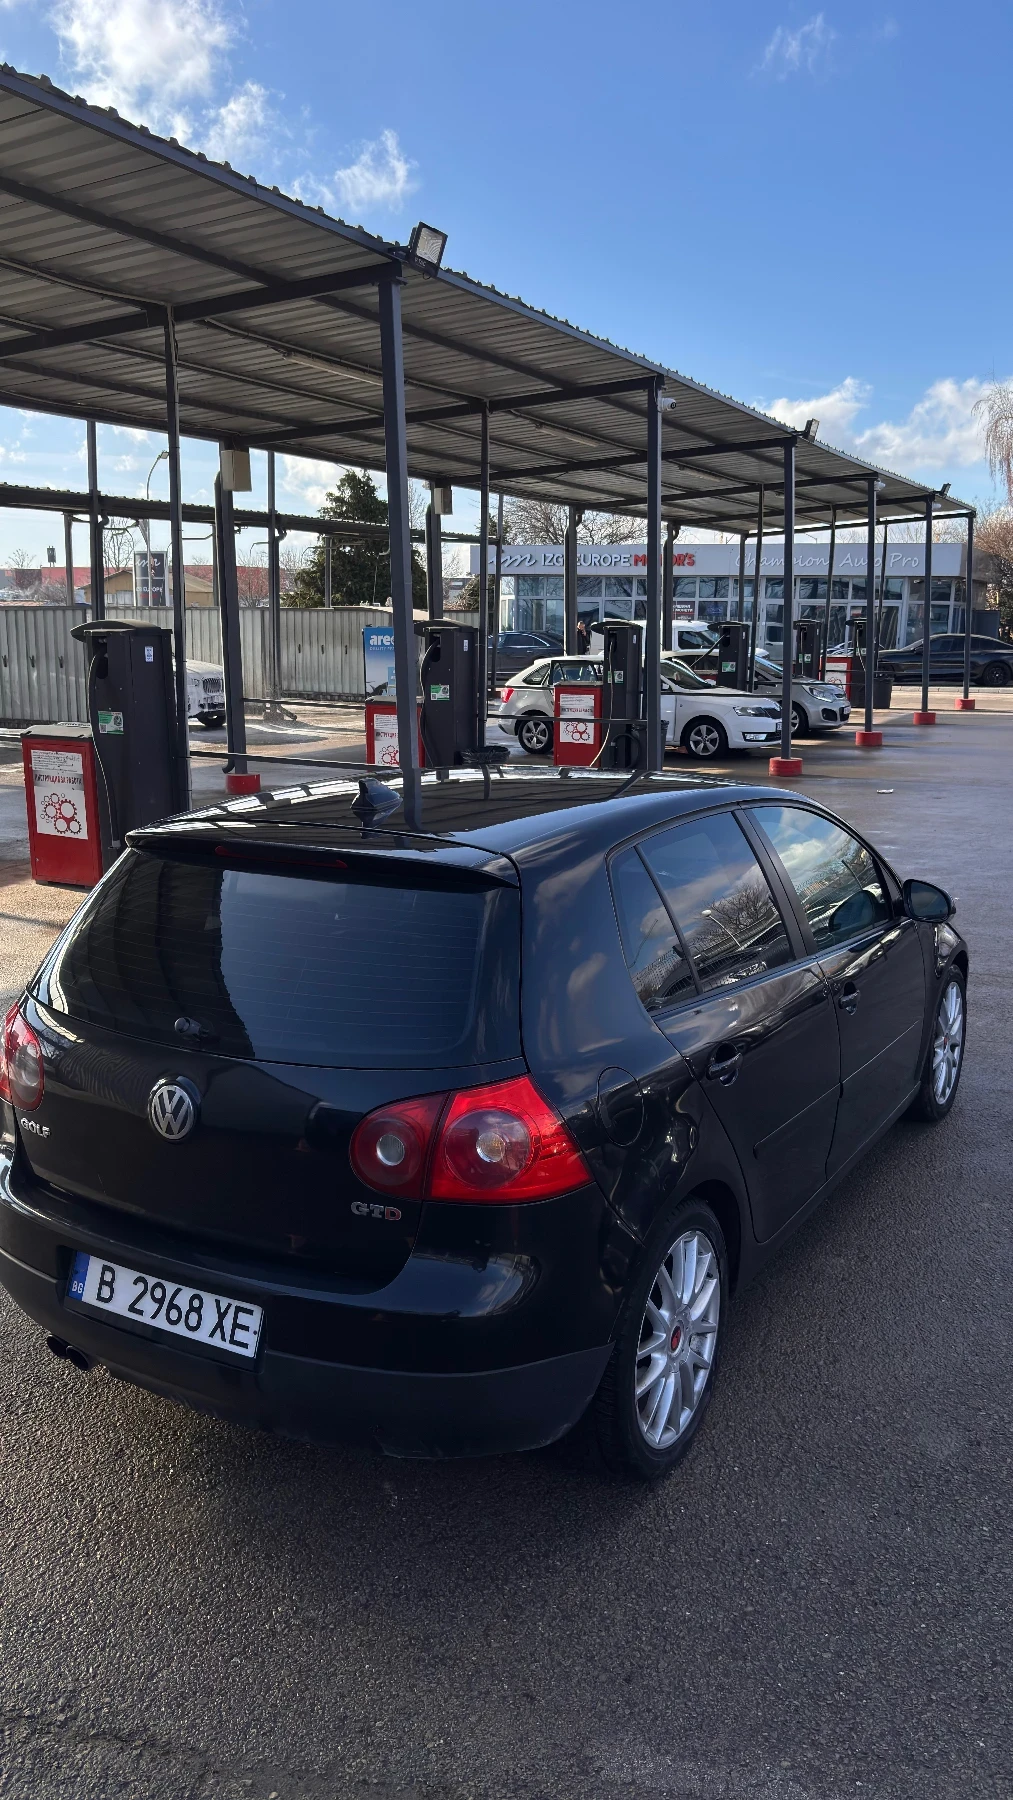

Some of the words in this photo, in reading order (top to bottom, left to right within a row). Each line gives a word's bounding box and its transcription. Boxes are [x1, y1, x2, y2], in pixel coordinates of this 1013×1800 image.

[576, 553, 631, 567] EUROPE
[839, 552, 882, 568] Auo
[889, 552, 919, 568] Pro
[20, 1117, 51, 1139] GOLF
[351, 1201, 402, 1220] GTD
[72, 1280, 83, 1294] BG
[96, 1264, 116, 1304] B
[128, 1276, 204, 1332] 2968
[208, 1298, 254, 1349] XE
